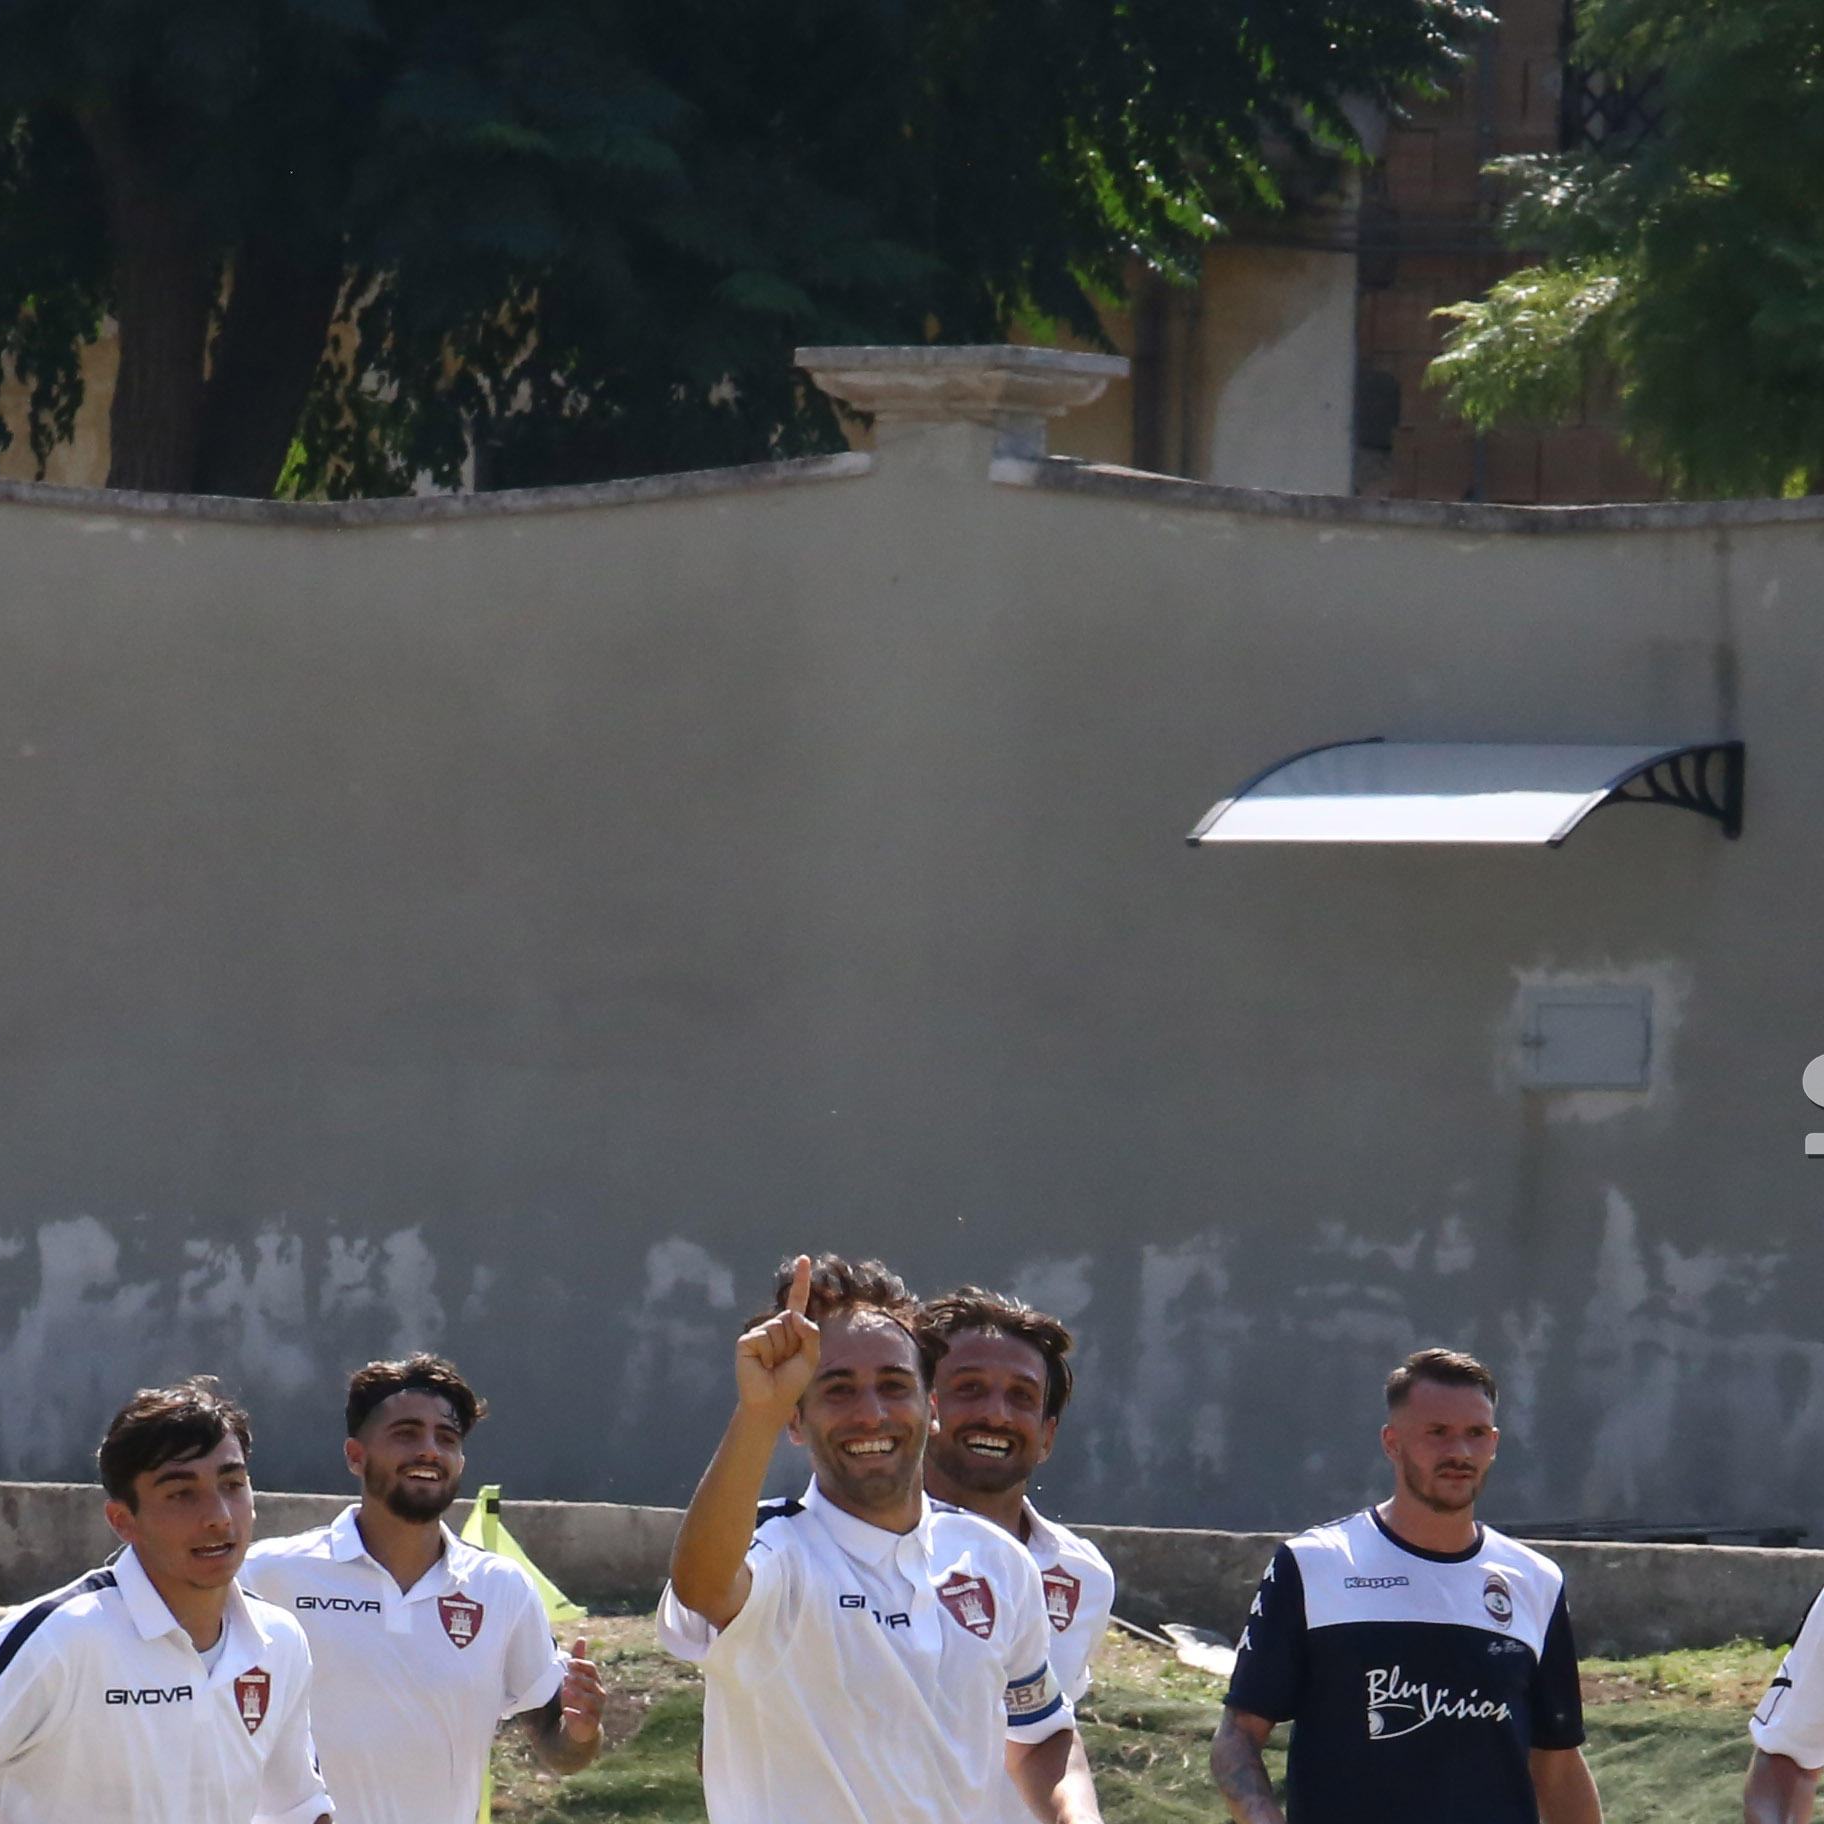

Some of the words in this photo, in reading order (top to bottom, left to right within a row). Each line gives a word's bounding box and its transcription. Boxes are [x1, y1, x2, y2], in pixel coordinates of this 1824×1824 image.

[1344, 1576, 1409, 1589] Kappa
[295, 1596, 381, 1614] GIVOVA
[105, 1685, 193, 1705] GIVOVA
